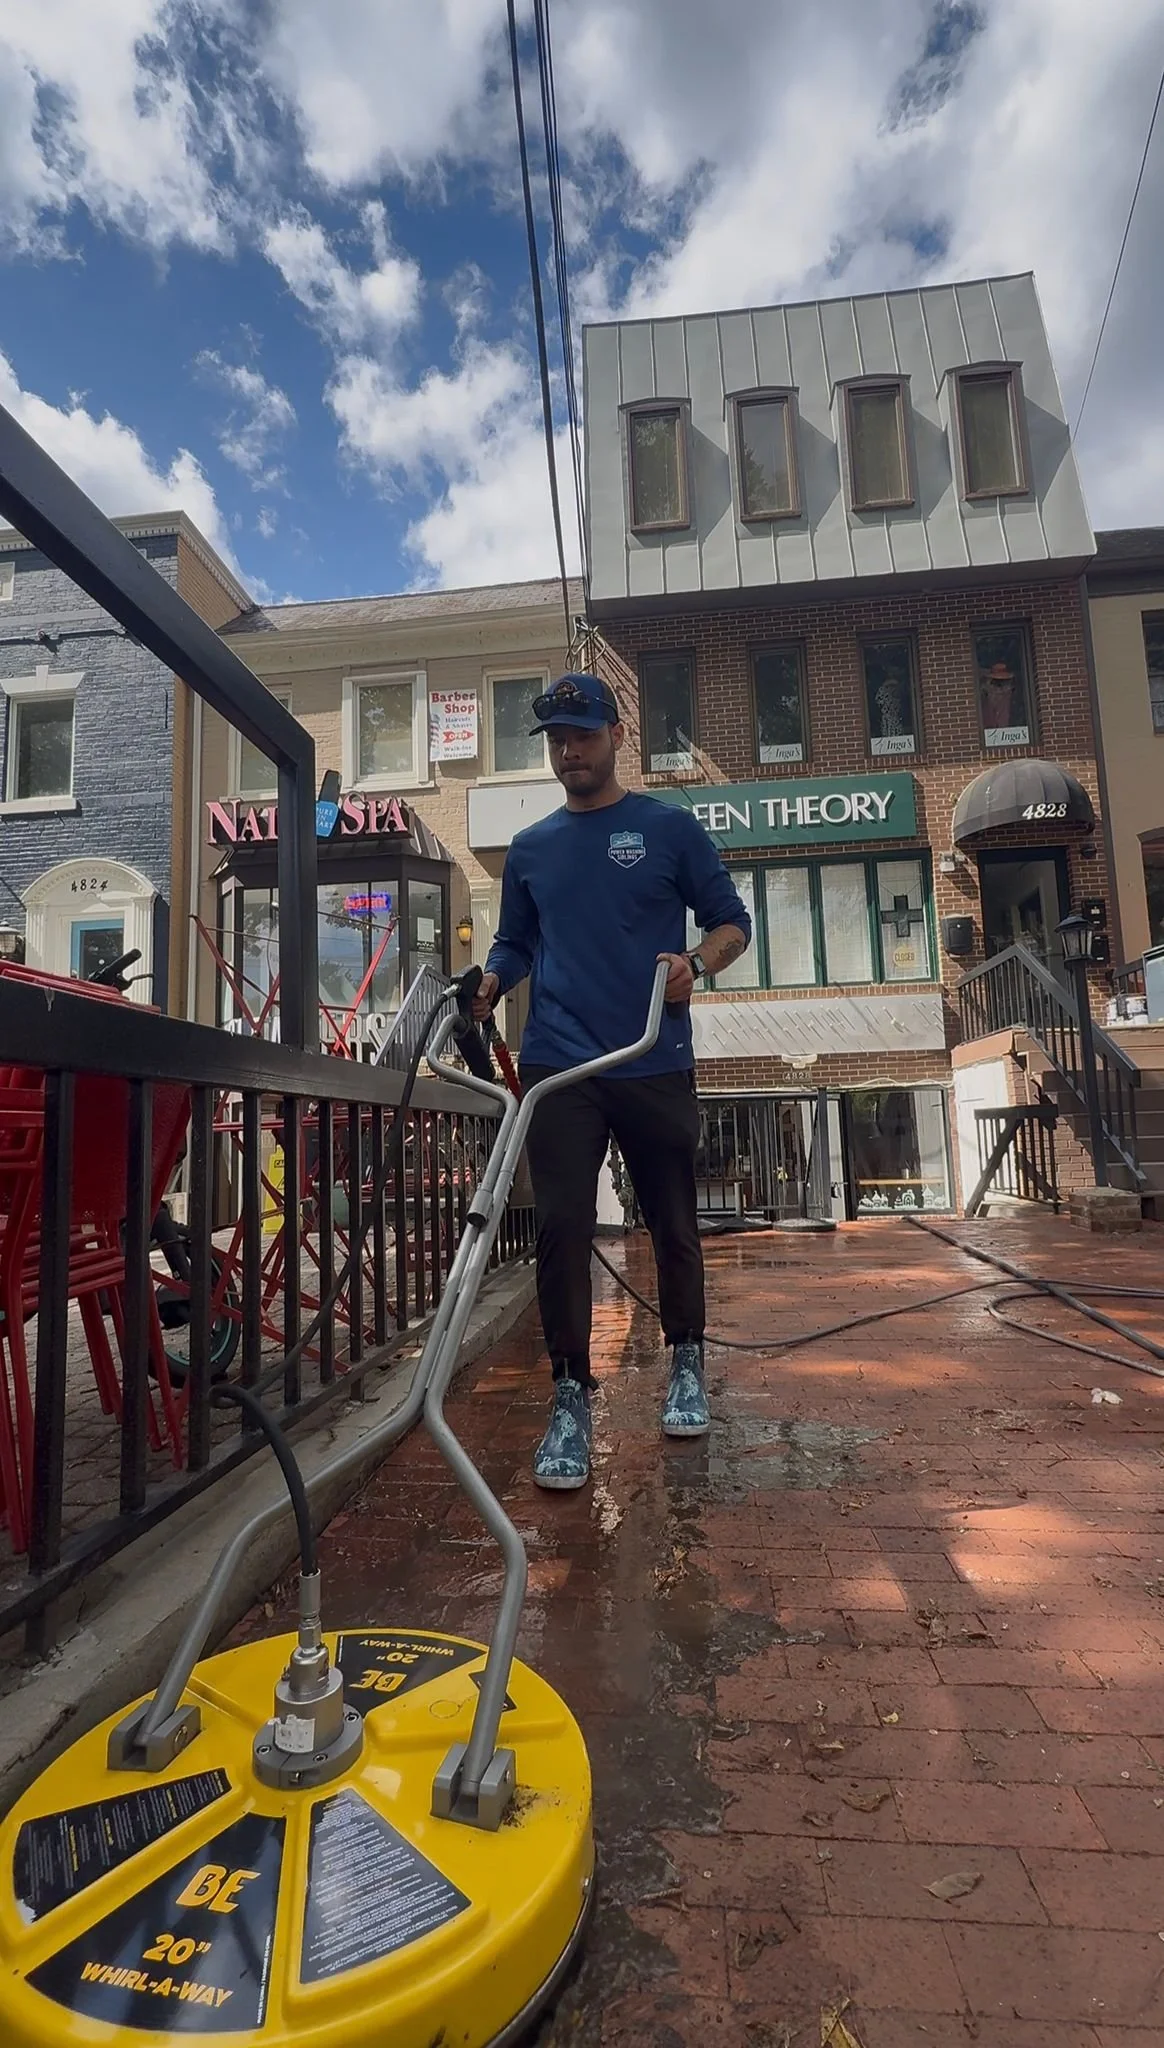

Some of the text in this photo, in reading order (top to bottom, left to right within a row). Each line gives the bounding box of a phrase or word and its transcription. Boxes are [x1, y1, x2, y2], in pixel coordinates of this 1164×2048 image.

[431, 691, 476, 703] Barber
[444, 703, 475, 714] Shop
[448, 731, 469, 741] OPEN
[1000, 729, 1027, 741] Inga's
[887, 738, 912, 750] Inga's
[775, 747, 800, 759] Inga's
[692, 790, 893, 831] EEN THEORY
[1022, 803, 1067, 820] 4828
[71, 878, 108, 892] 4824
[894, 952, 915, 961] CLOSED
[359, 1639, 454, 1656] WHIRL-A-WAY
[349, 1669, 407, 1692] BE
[175, 1863, 261, 1914] BE
[79, 1962, 233, 2008] WHIRL-A-WAY
